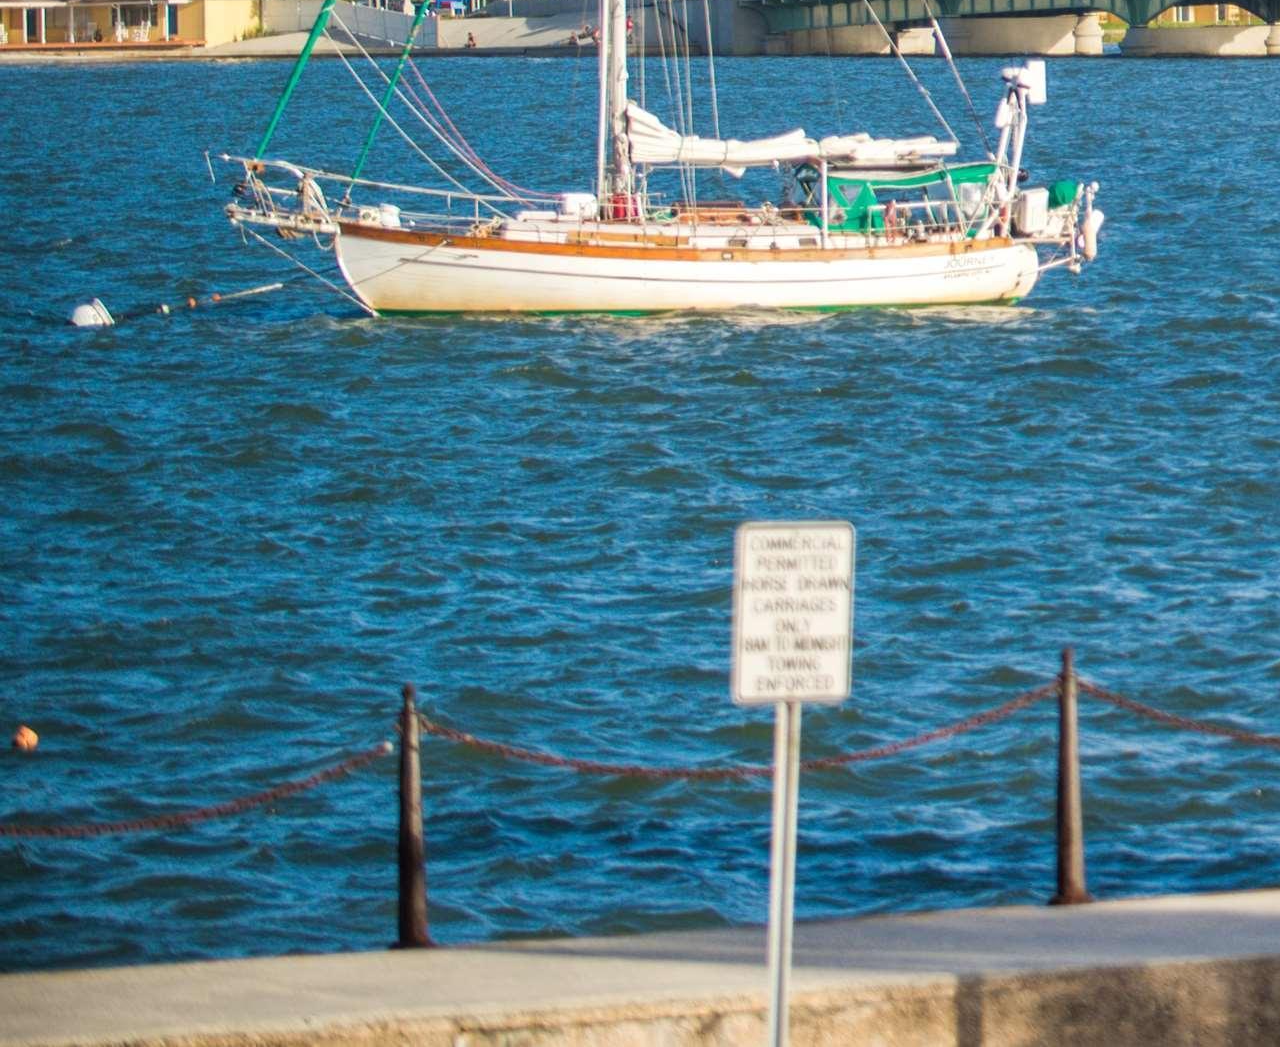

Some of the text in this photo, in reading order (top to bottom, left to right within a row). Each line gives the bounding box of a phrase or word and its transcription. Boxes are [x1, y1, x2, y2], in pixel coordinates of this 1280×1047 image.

[751, 536, 845, 551] COMMERCIAL
[756, 555, 838, 570] PERMITTED
[743, 577, 850, 592] HORSE DRAWN
[753, 598, 837, 613] CARRIAGES
[775, 618, 811, 633] ONLY
[776, 635, 790, 651] TO
[793, 635, 846, 651] MIDNIGHT
[767, 656, 818, 671] TOWING
[755, 675, 834, 691] ENFORCED
